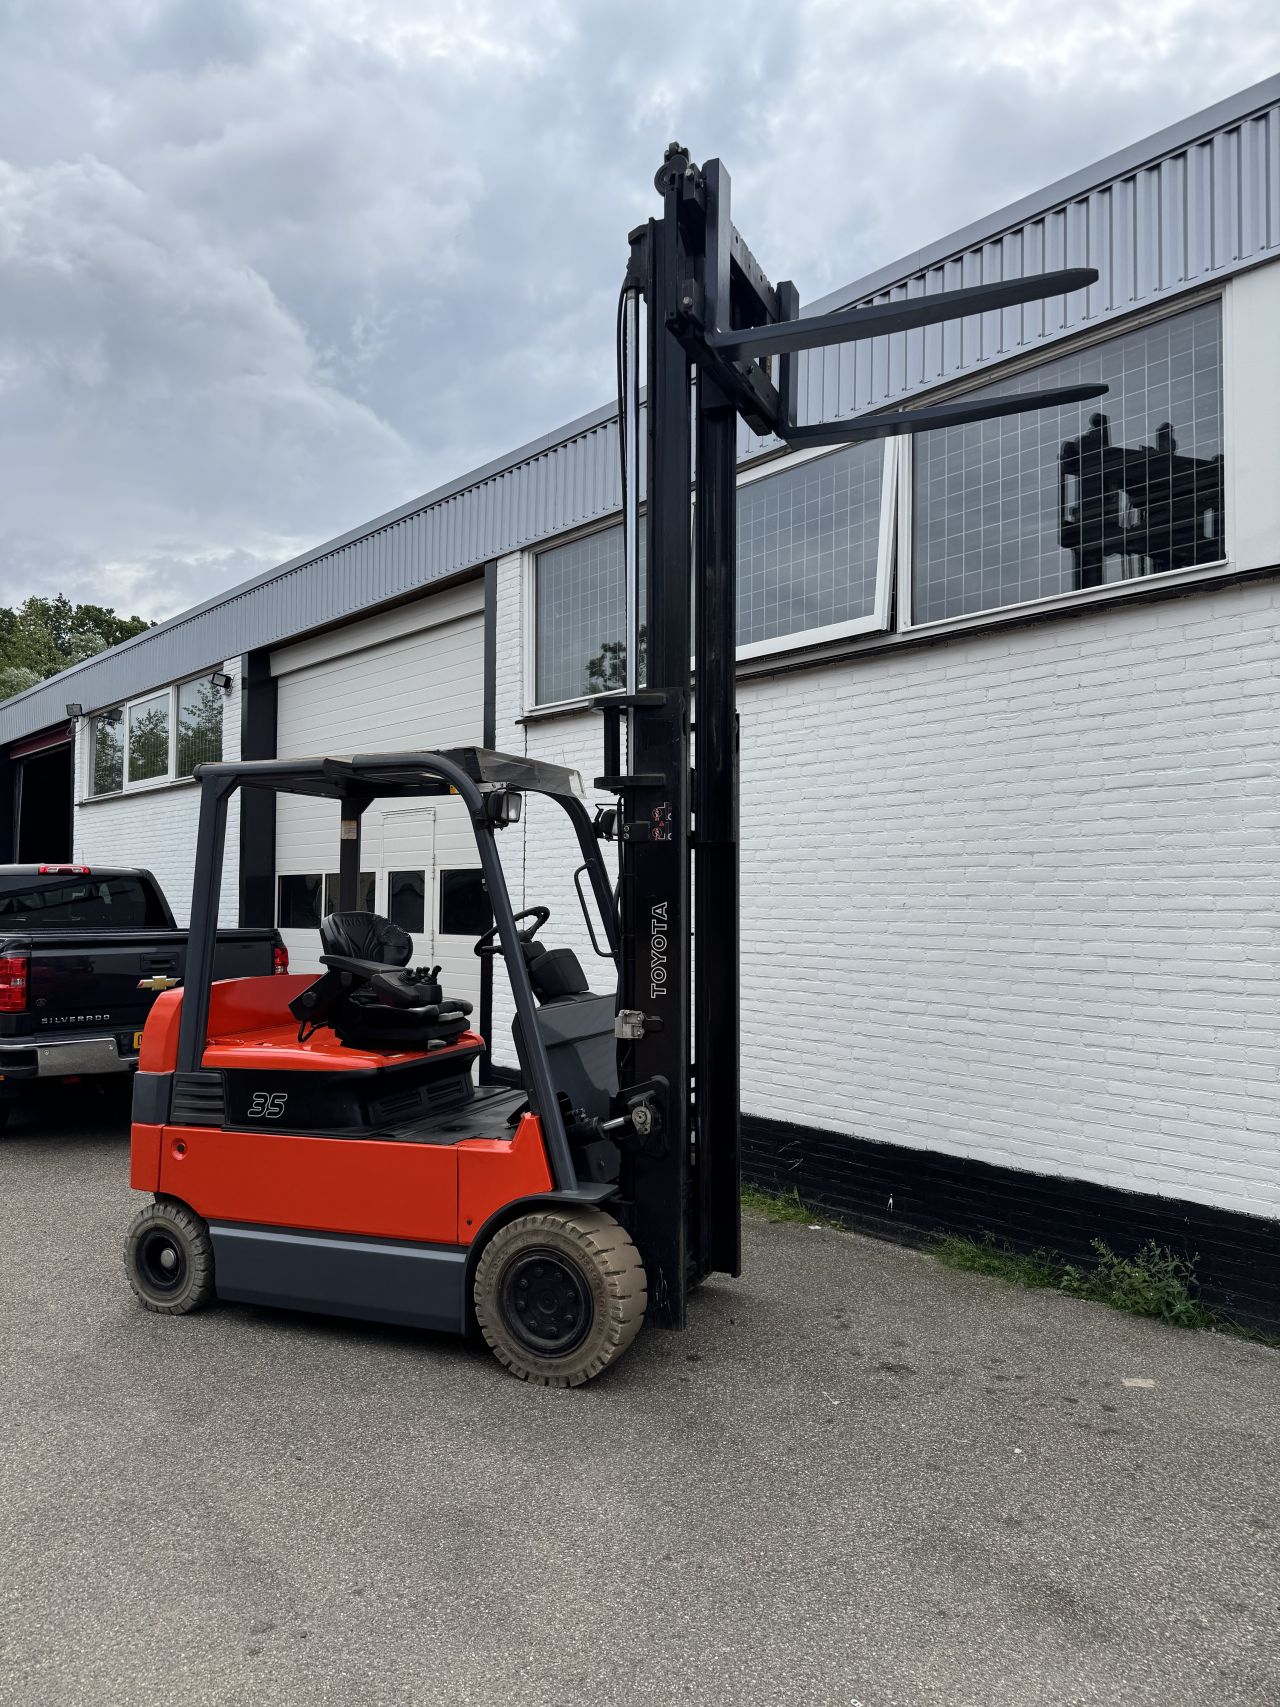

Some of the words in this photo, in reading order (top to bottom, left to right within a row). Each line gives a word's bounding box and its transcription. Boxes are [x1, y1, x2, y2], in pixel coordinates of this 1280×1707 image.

[651, 901, 668, 999] TOYOTA
[41, 1014, 110, 1024] SILVERADO
[247, 1092, 288, 1118] 35
